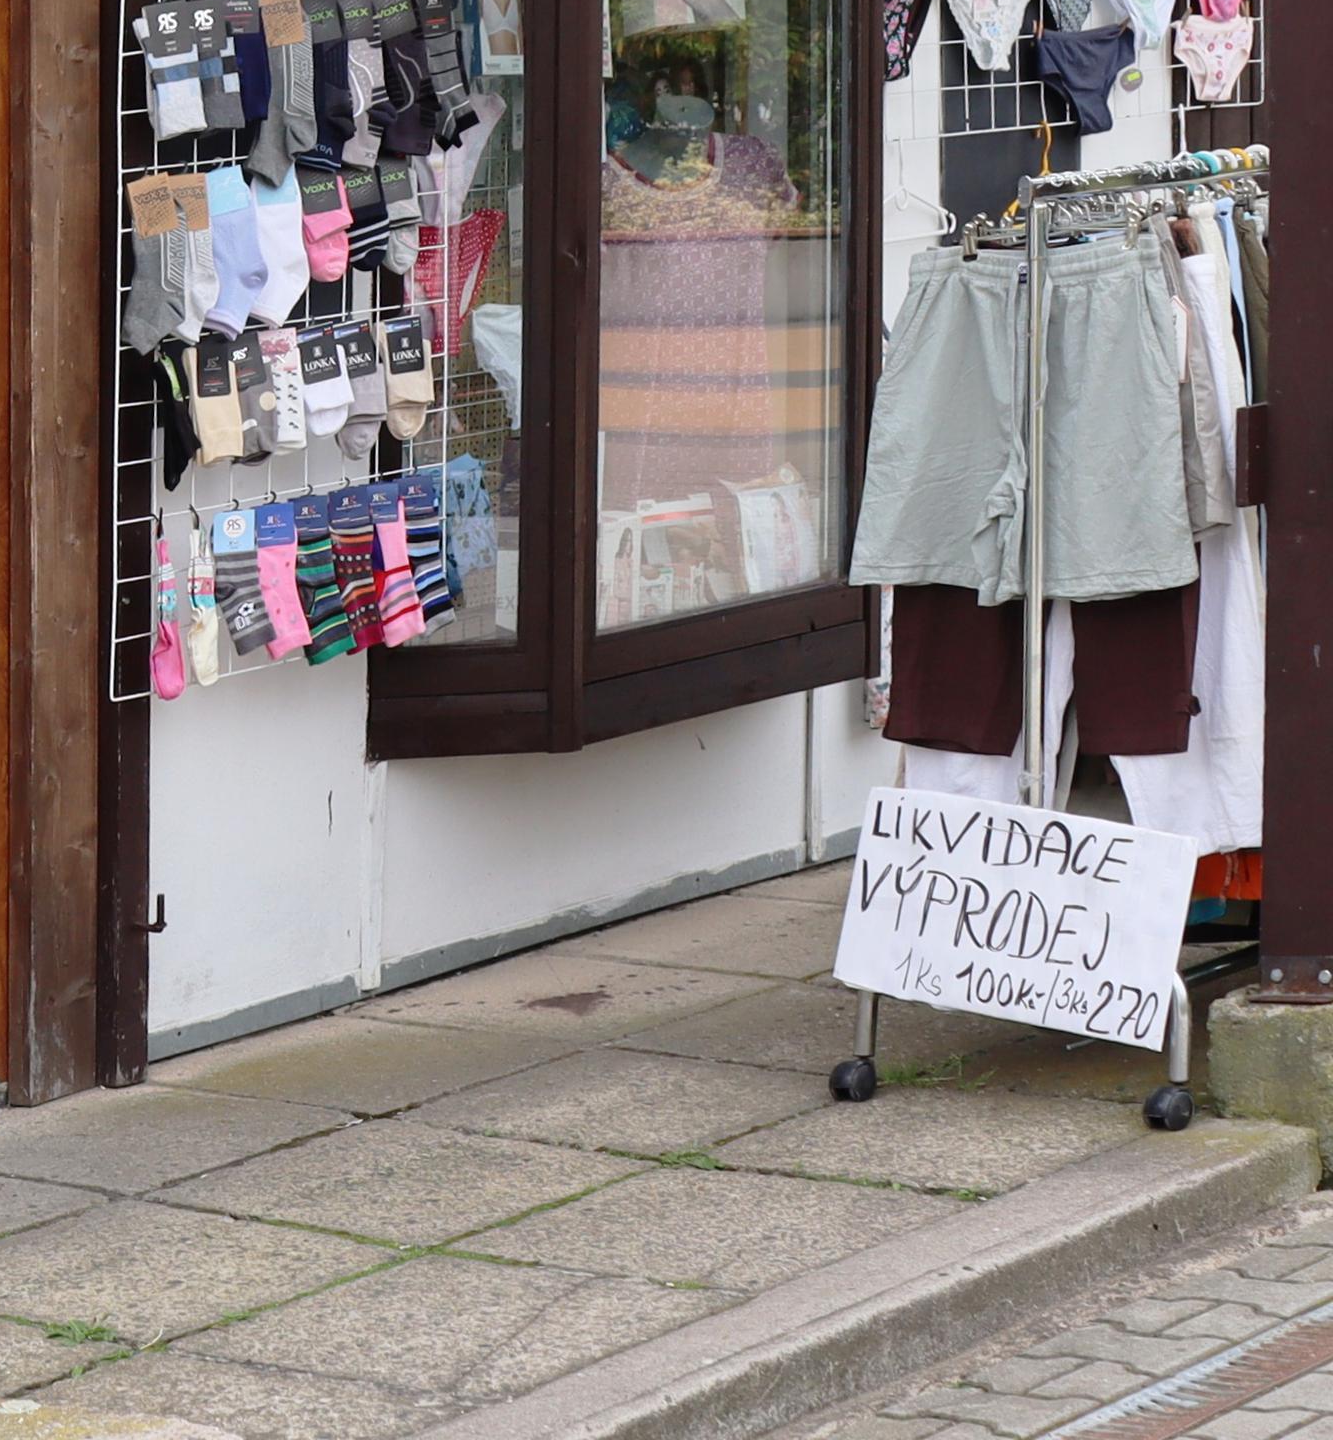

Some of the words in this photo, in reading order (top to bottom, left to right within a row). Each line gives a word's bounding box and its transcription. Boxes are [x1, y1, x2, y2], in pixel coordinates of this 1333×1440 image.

[347, 352, 372, 365] ONKA
[392, 348, 422, 362] LONKA
[860, 854, 1110, 971] VÝPRODEJ
[1085, 980, 1160, 1040] 270
